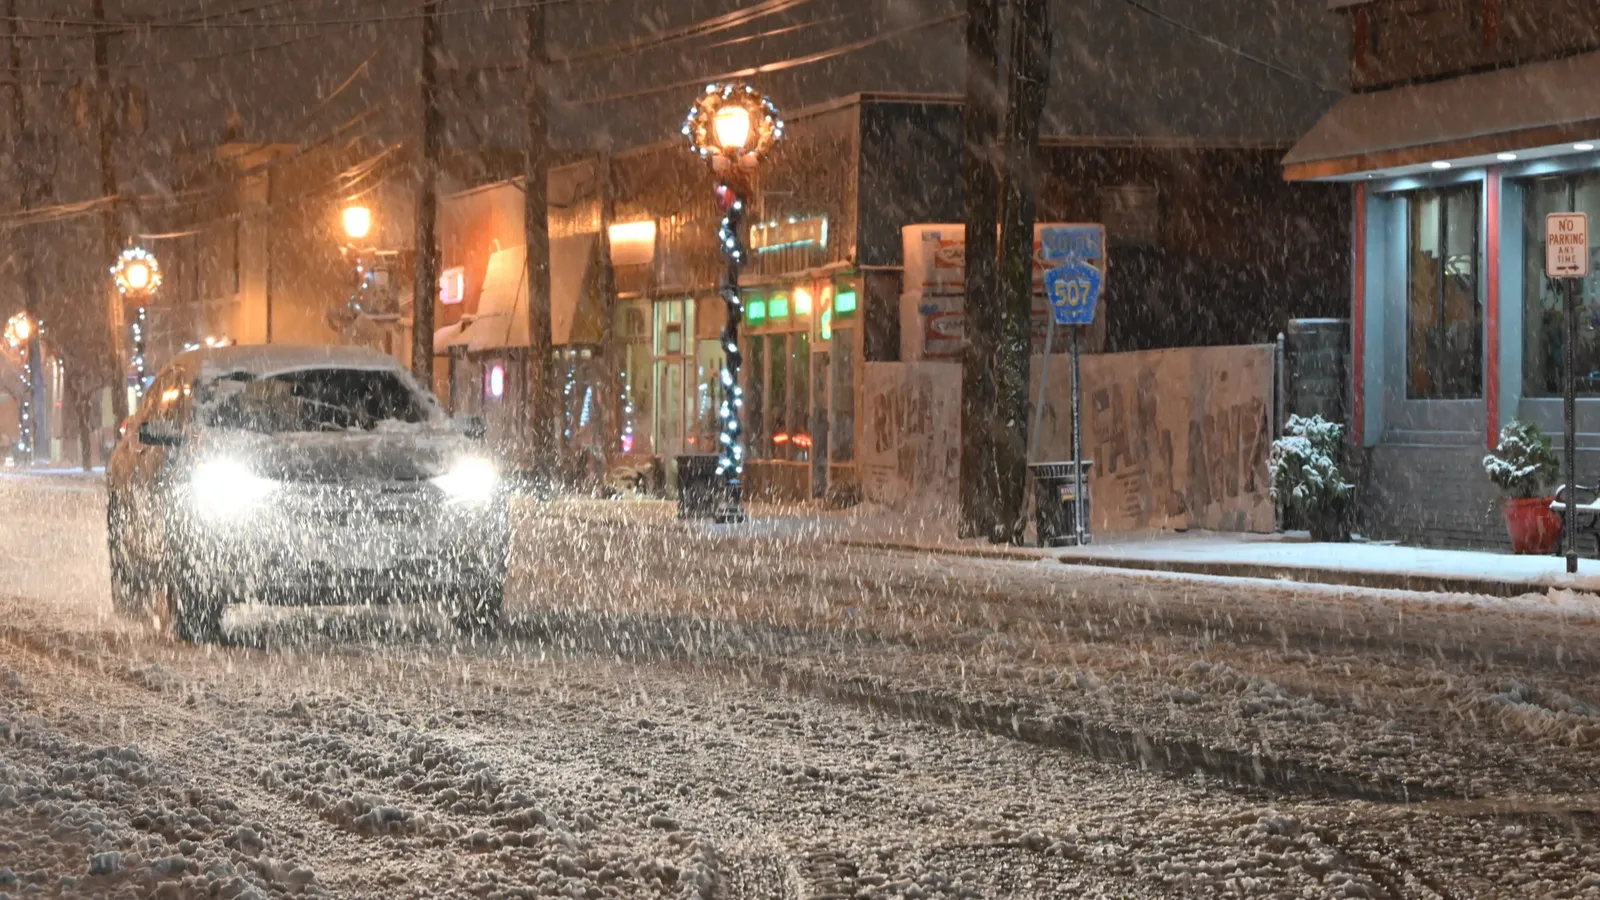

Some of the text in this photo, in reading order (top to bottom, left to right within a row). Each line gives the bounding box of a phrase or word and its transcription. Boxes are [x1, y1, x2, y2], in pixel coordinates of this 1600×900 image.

[1558, 219, 1574, 231] NO
[1549, 233, 1584, 245] PARKING
[1557, 255, 1576, 263] TIME
[1055, 280, 1091, 306] 507
